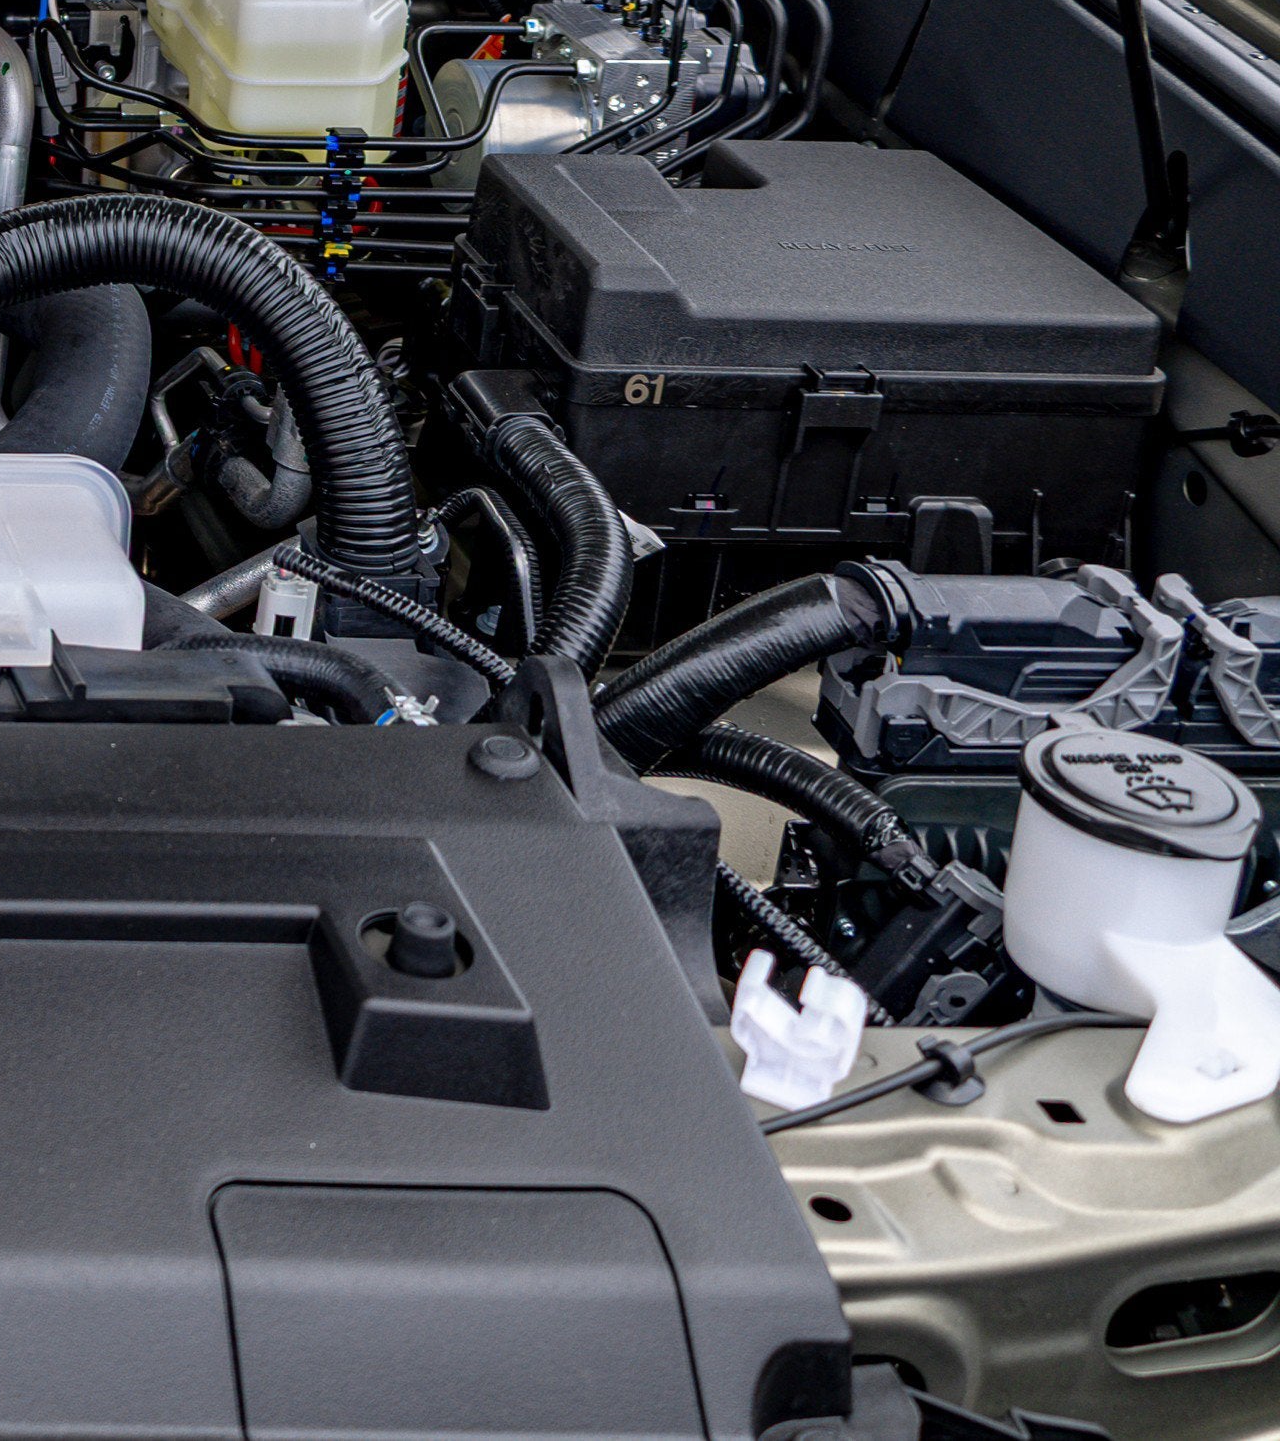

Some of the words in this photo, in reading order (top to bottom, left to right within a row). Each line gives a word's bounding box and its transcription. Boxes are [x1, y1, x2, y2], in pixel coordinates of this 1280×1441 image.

[777, 242, 841, 251] RELAY
[863, 244, 921, 253] FUSE
[624, 374, 665, 405] 61
[1061, 753, 1132, 764] WASHER
[1136, 754, 1184, 764] FLUID
